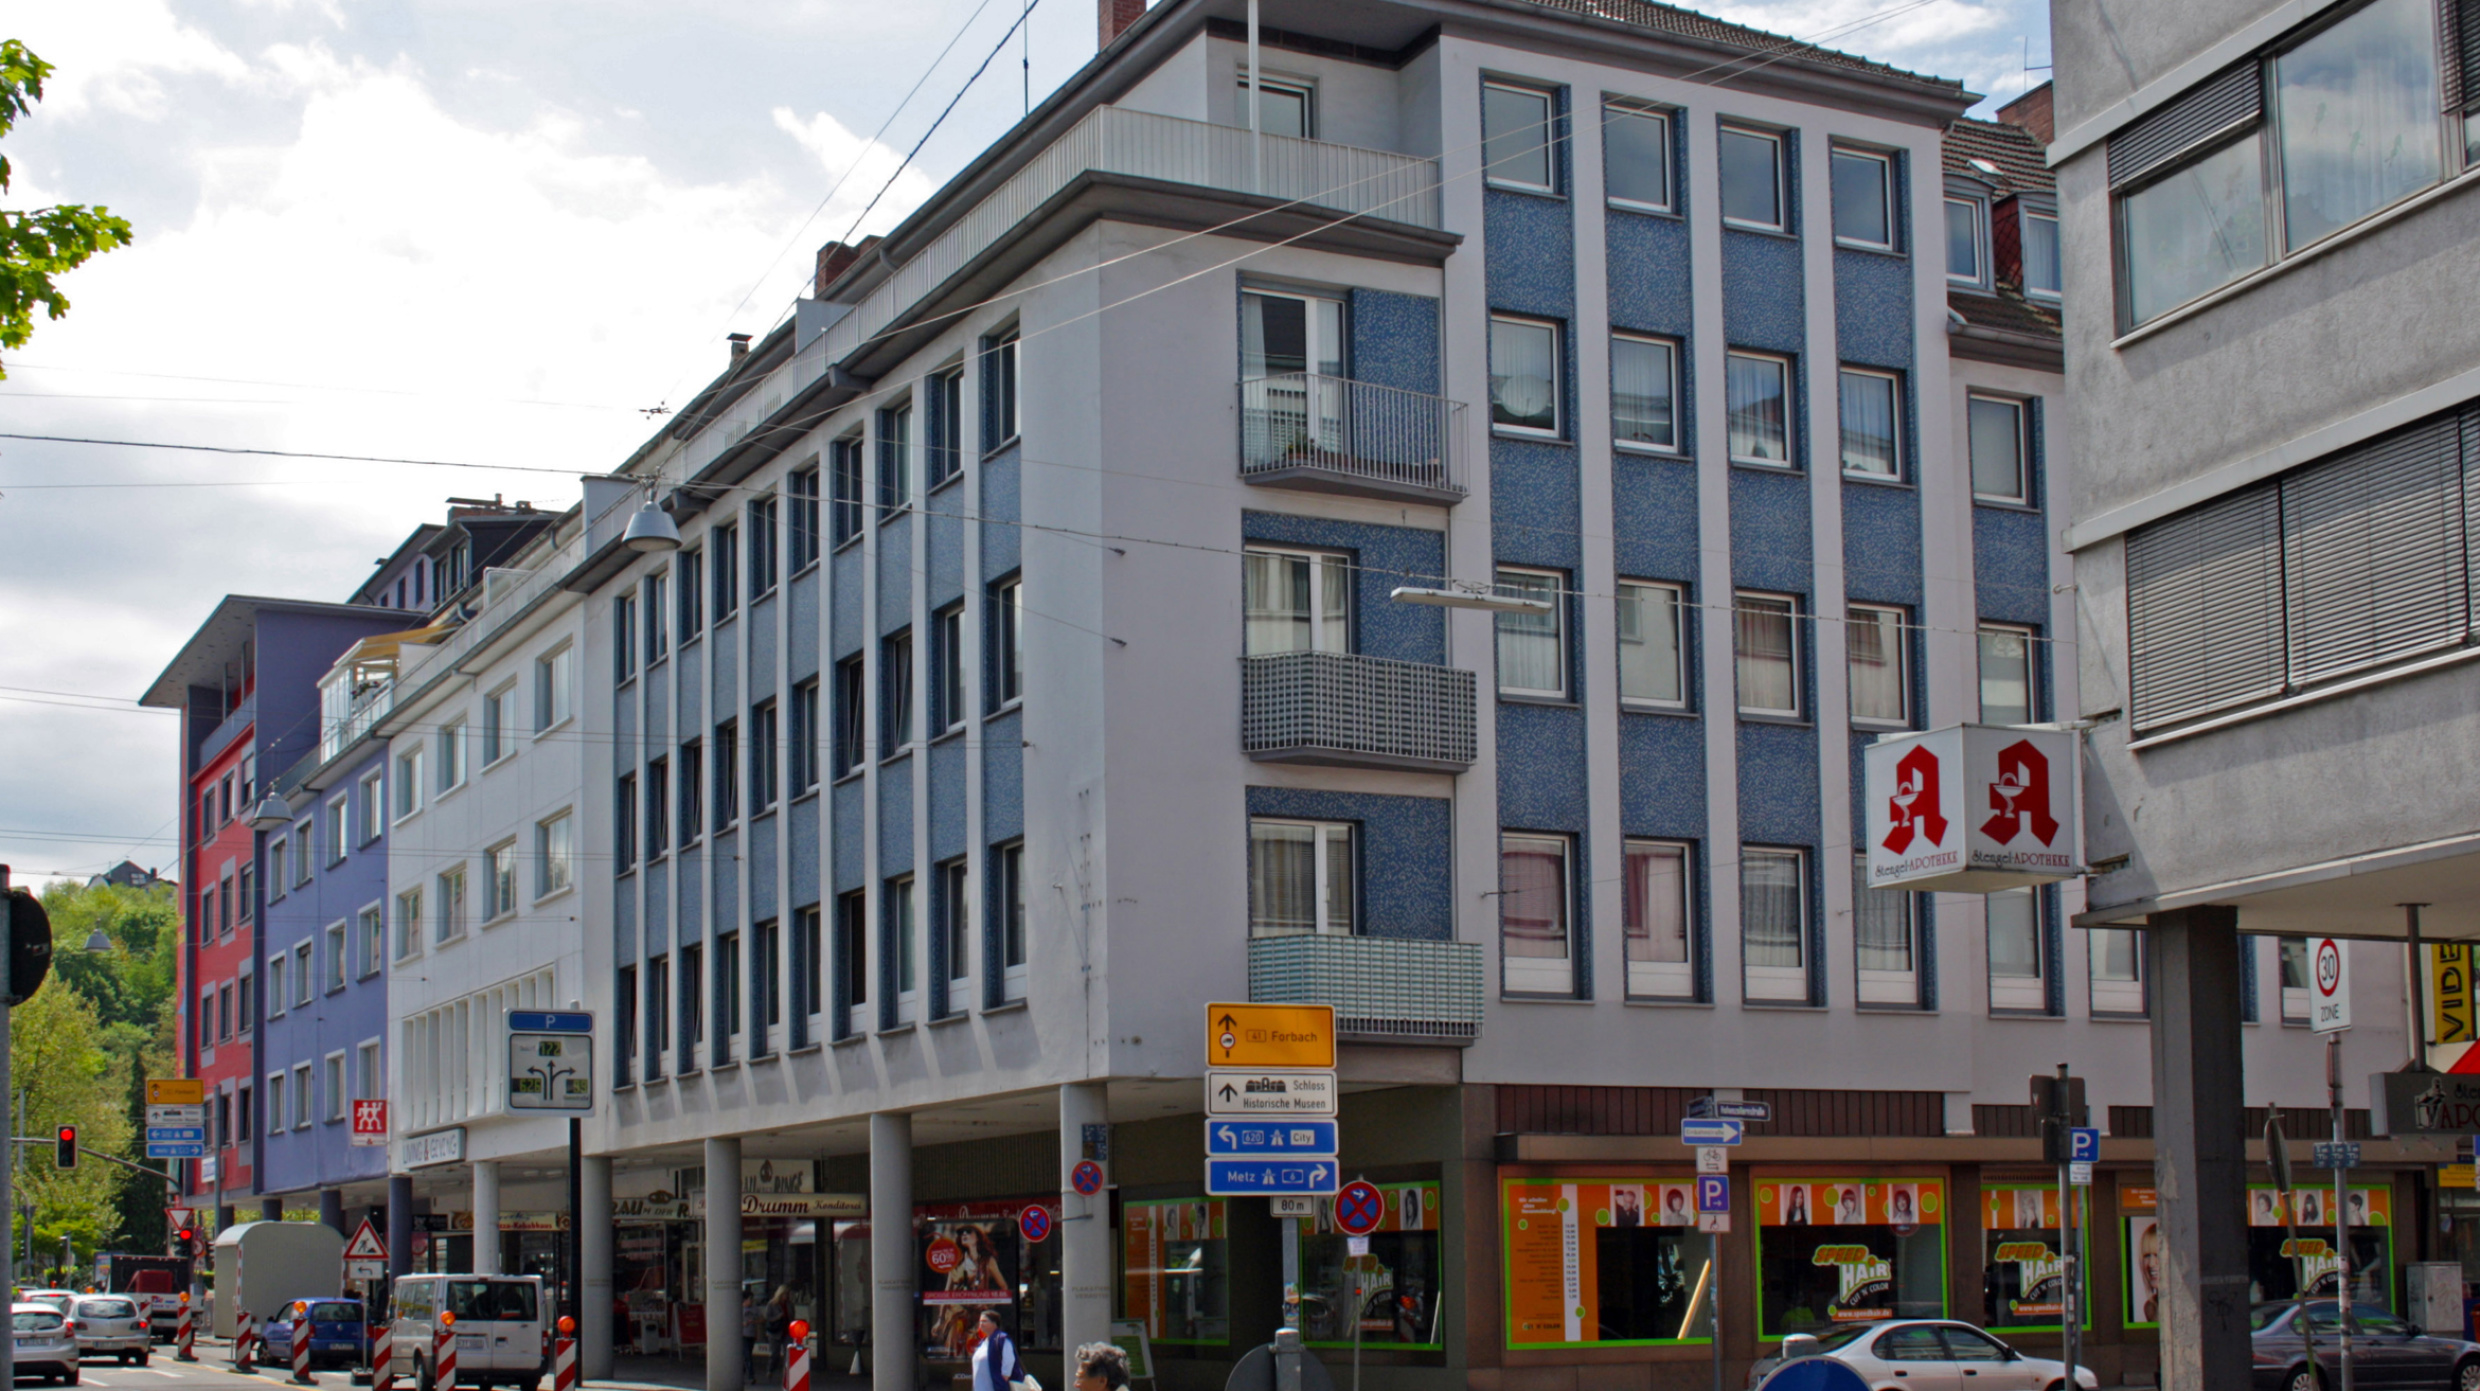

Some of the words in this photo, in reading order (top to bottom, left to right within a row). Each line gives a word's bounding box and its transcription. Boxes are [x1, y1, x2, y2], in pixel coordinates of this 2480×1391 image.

[2320, 953, 2335, 982] 30
[2439, 944, 2464, 1041] VIDE
[2320, 1003, 2340, 1023] ZONE
[545, 1014, 556, 1029] P
[1251, 1031, 1262, 1041] 41
[1271, 1031, 1318, 1043] Forbach
[1293, 1080, 1326, 1091] Schloss
[1243, 1098, 1290, 1109] Historische
[1294, 1098, 1326, 1109] Museen
[1244, 1131, 1261, 1143] 620
[1292, 1131, 1312, 1145] City
[2071, 1131, 2092, 1158] P
[1227, 1170, 1256, 1182] Metz
[1705, 1180, 1722, 1208] P
[743, 1194, 810, 1215] Drumm
[1281, 1200, 1295, 1212] 80
[1296, 1202, 1305, 1211] m
[1814, 1247, 1868, 1263] SPEED
[1997, 1243, 2046, 1260] SPEED
[1849, 1294, 1862, 1306] CUT
[1869, 1282, 1890, 1293] COLOR
[2029, 1287, 2042, 1301] CUT
